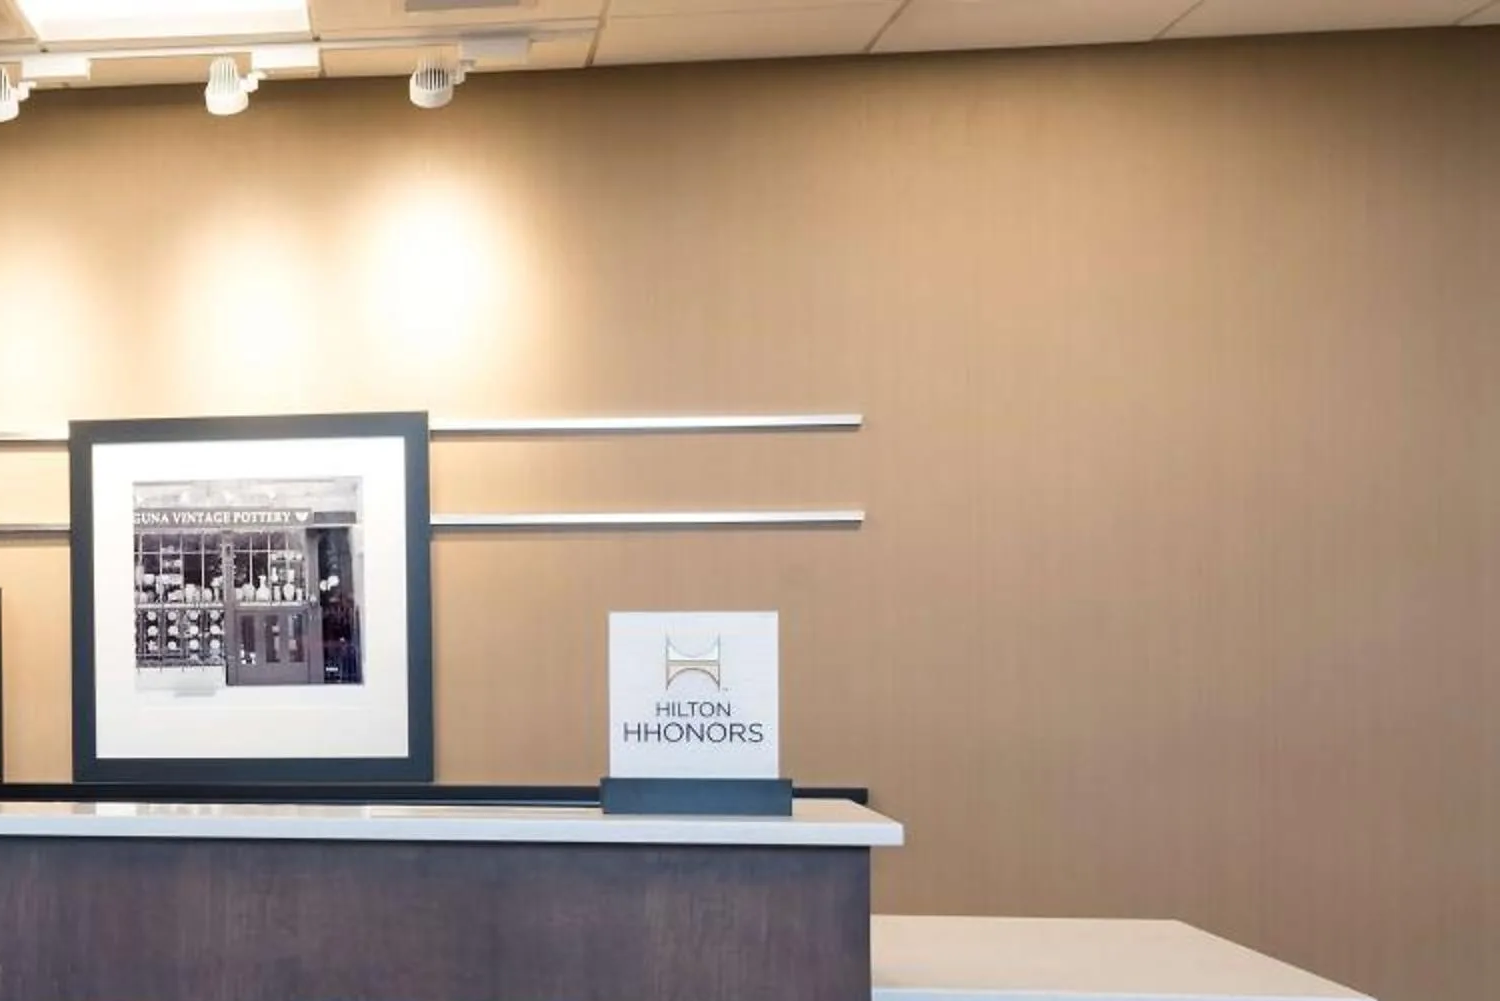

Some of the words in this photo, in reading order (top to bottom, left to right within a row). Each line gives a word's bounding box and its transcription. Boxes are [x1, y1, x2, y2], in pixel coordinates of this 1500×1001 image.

[172, 510, 230, 523] VINTAGE
[233, 510, 291, 523] POTTERY
[655, 701, 731, 717] HILTON
[623, 721, 764, 743] HHONORS
